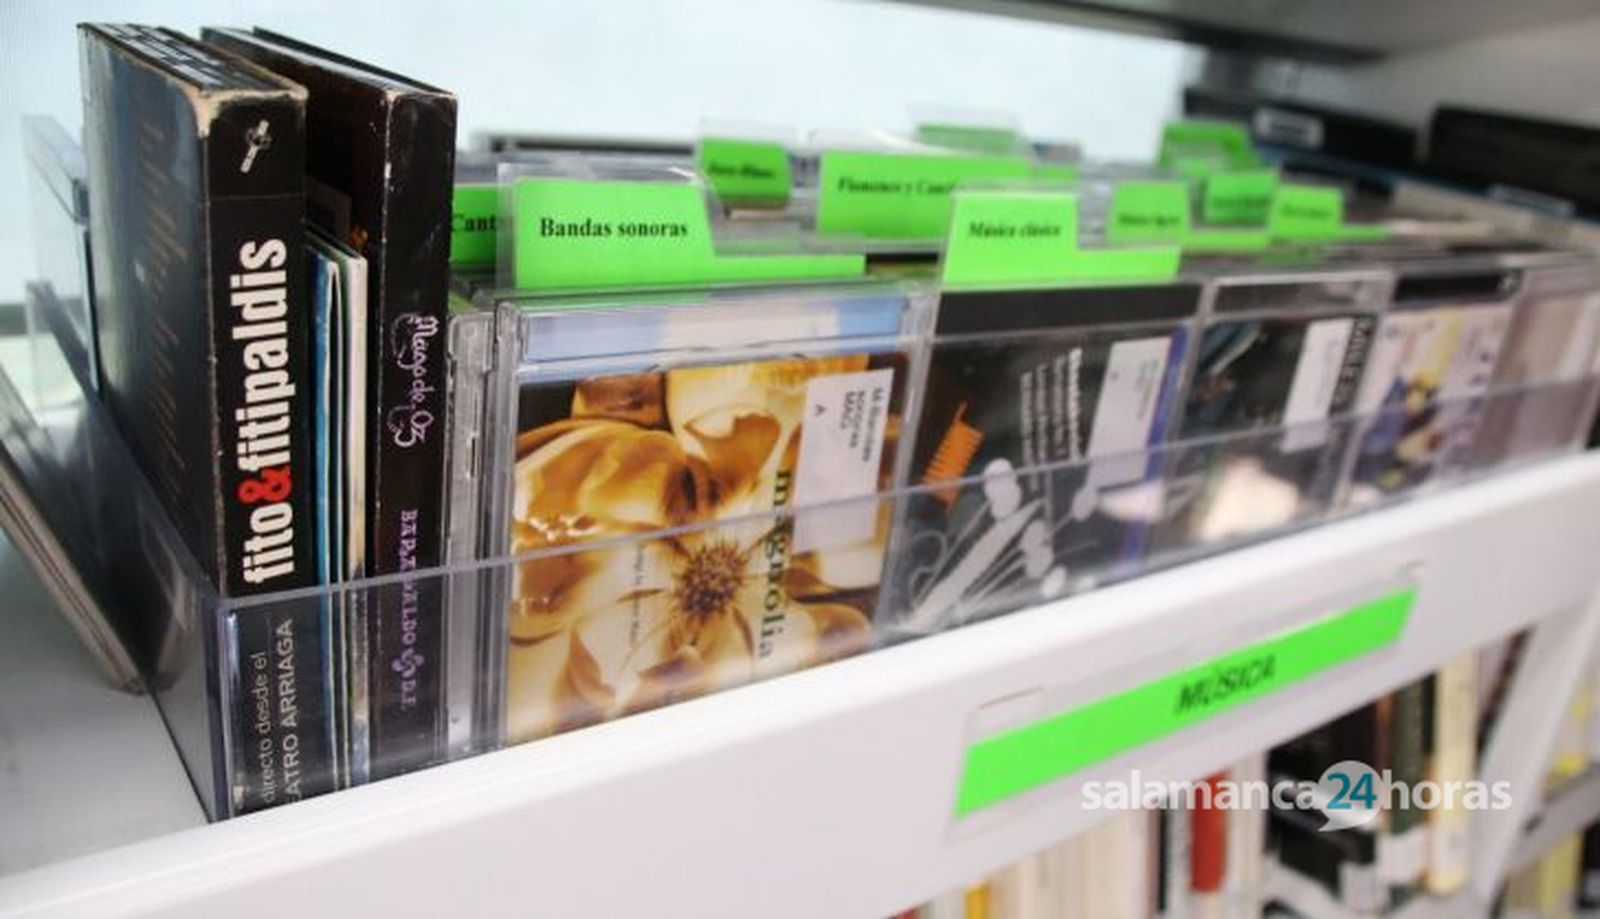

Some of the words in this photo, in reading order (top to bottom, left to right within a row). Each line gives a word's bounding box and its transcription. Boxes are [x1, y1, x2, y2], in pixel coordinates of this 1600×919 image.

[540, 216, 612, 239] Bandas
[617, 221, 688, 237] sonoras
[231, 238, 296, 585] fito&fitipaldis
[758, 470, 792, 660] magnolia
[250, 650, 268, 672] el
[276, 618, 299, 727] ARRIAGA
[252, 674, 272, 735] desde
